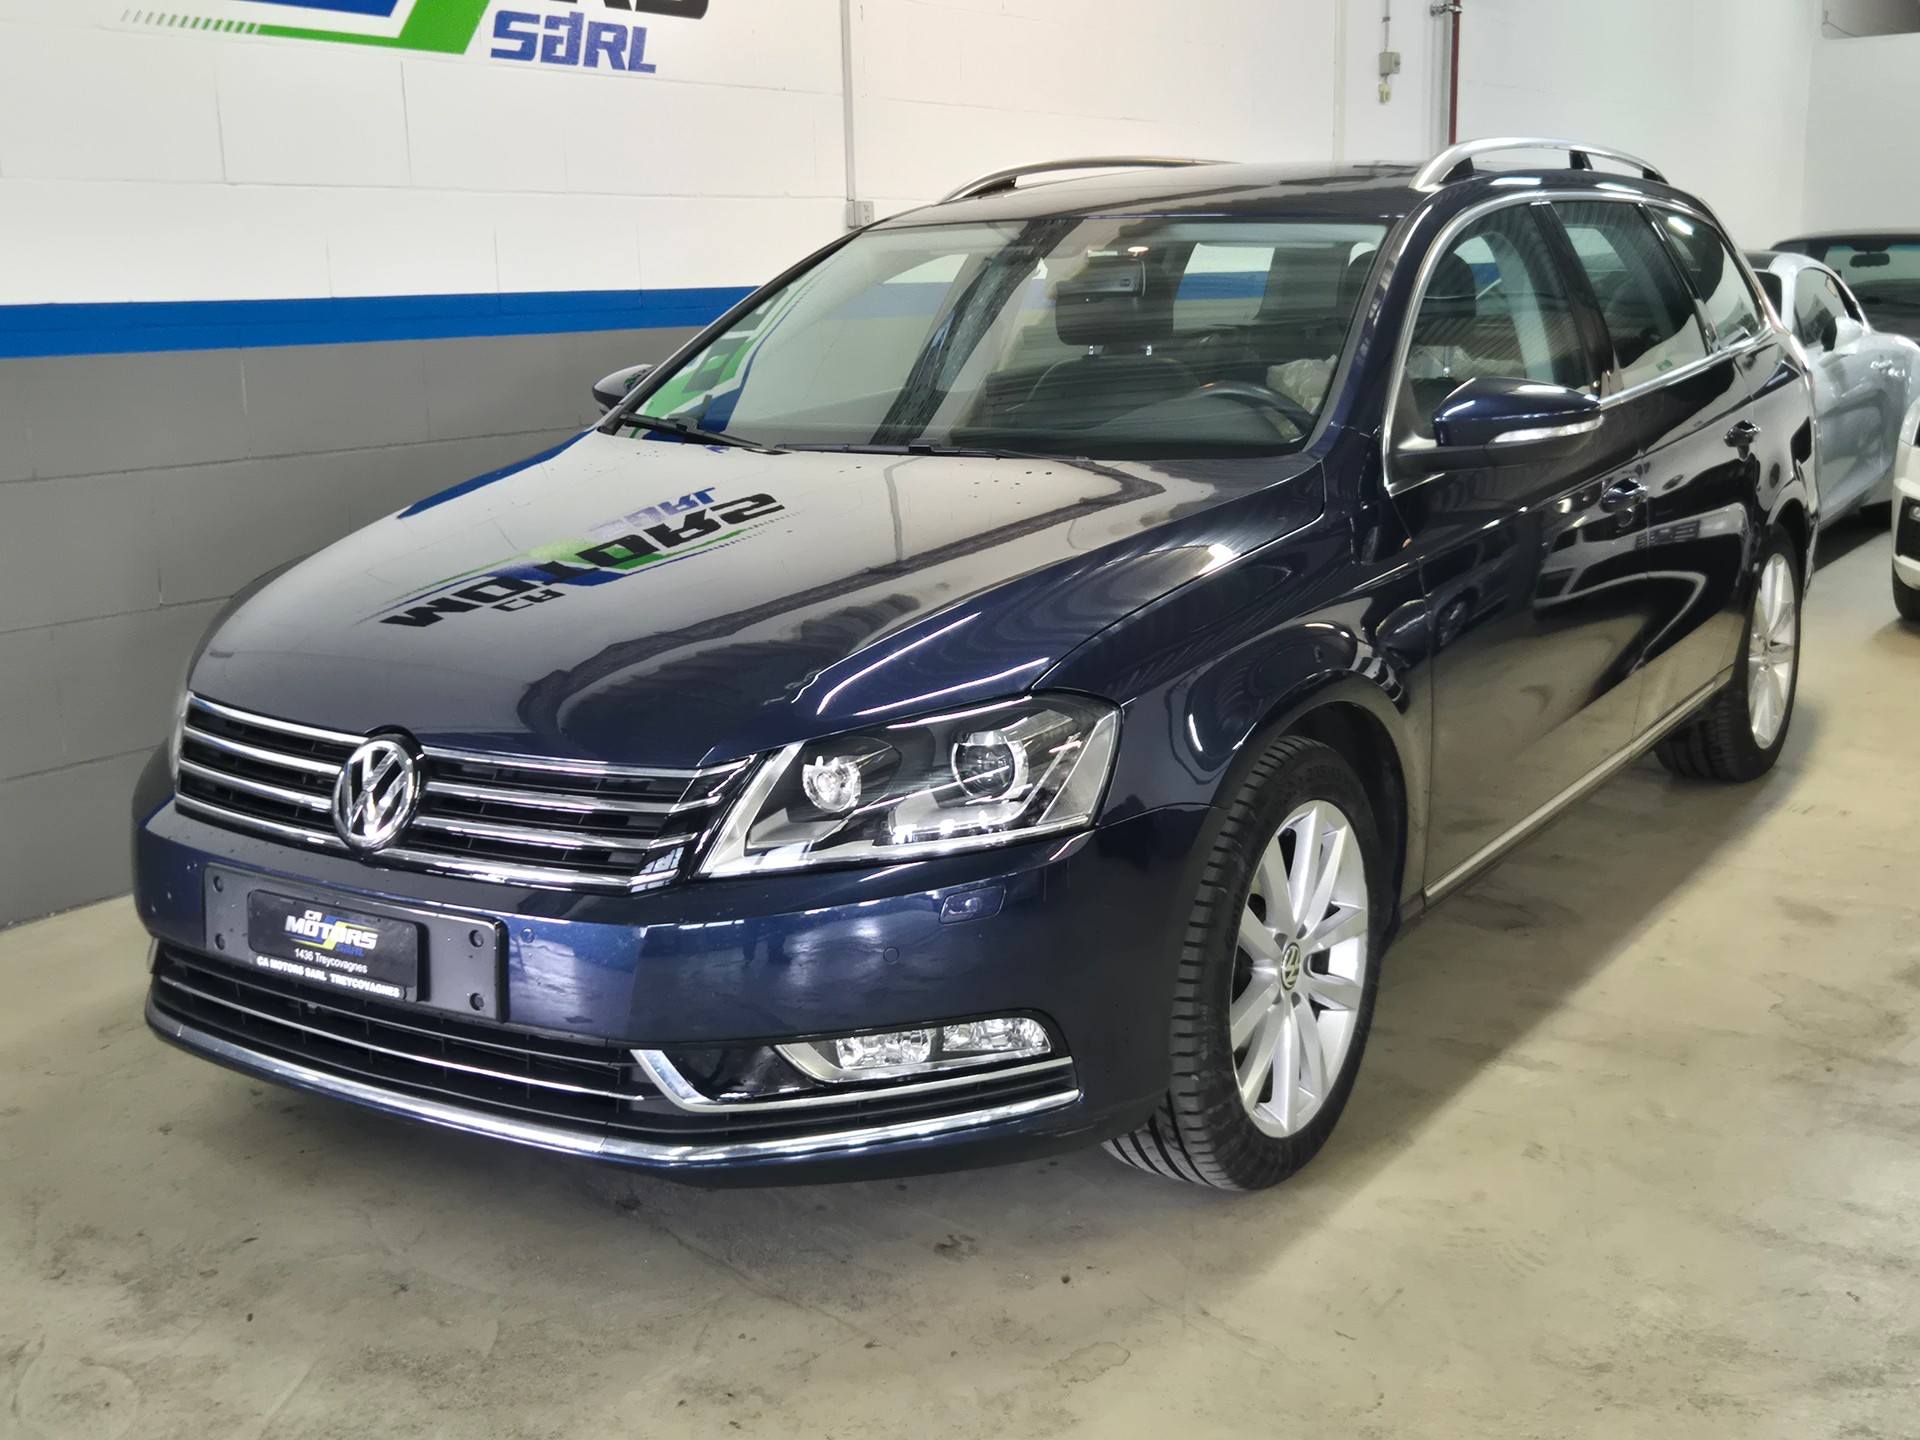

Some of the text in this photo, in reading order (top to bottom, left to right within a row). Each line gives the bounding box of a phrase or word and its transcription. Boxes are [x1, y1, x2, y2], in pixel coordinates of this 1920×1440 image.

[304, 909, 322, 921] CA
[284, 914, 378, 950] MOTORS
[256, 956, 400, 998] CA MOTORS SARL TREYCOVAGNES
[315, 952, 368, 974] Treycovagnes
